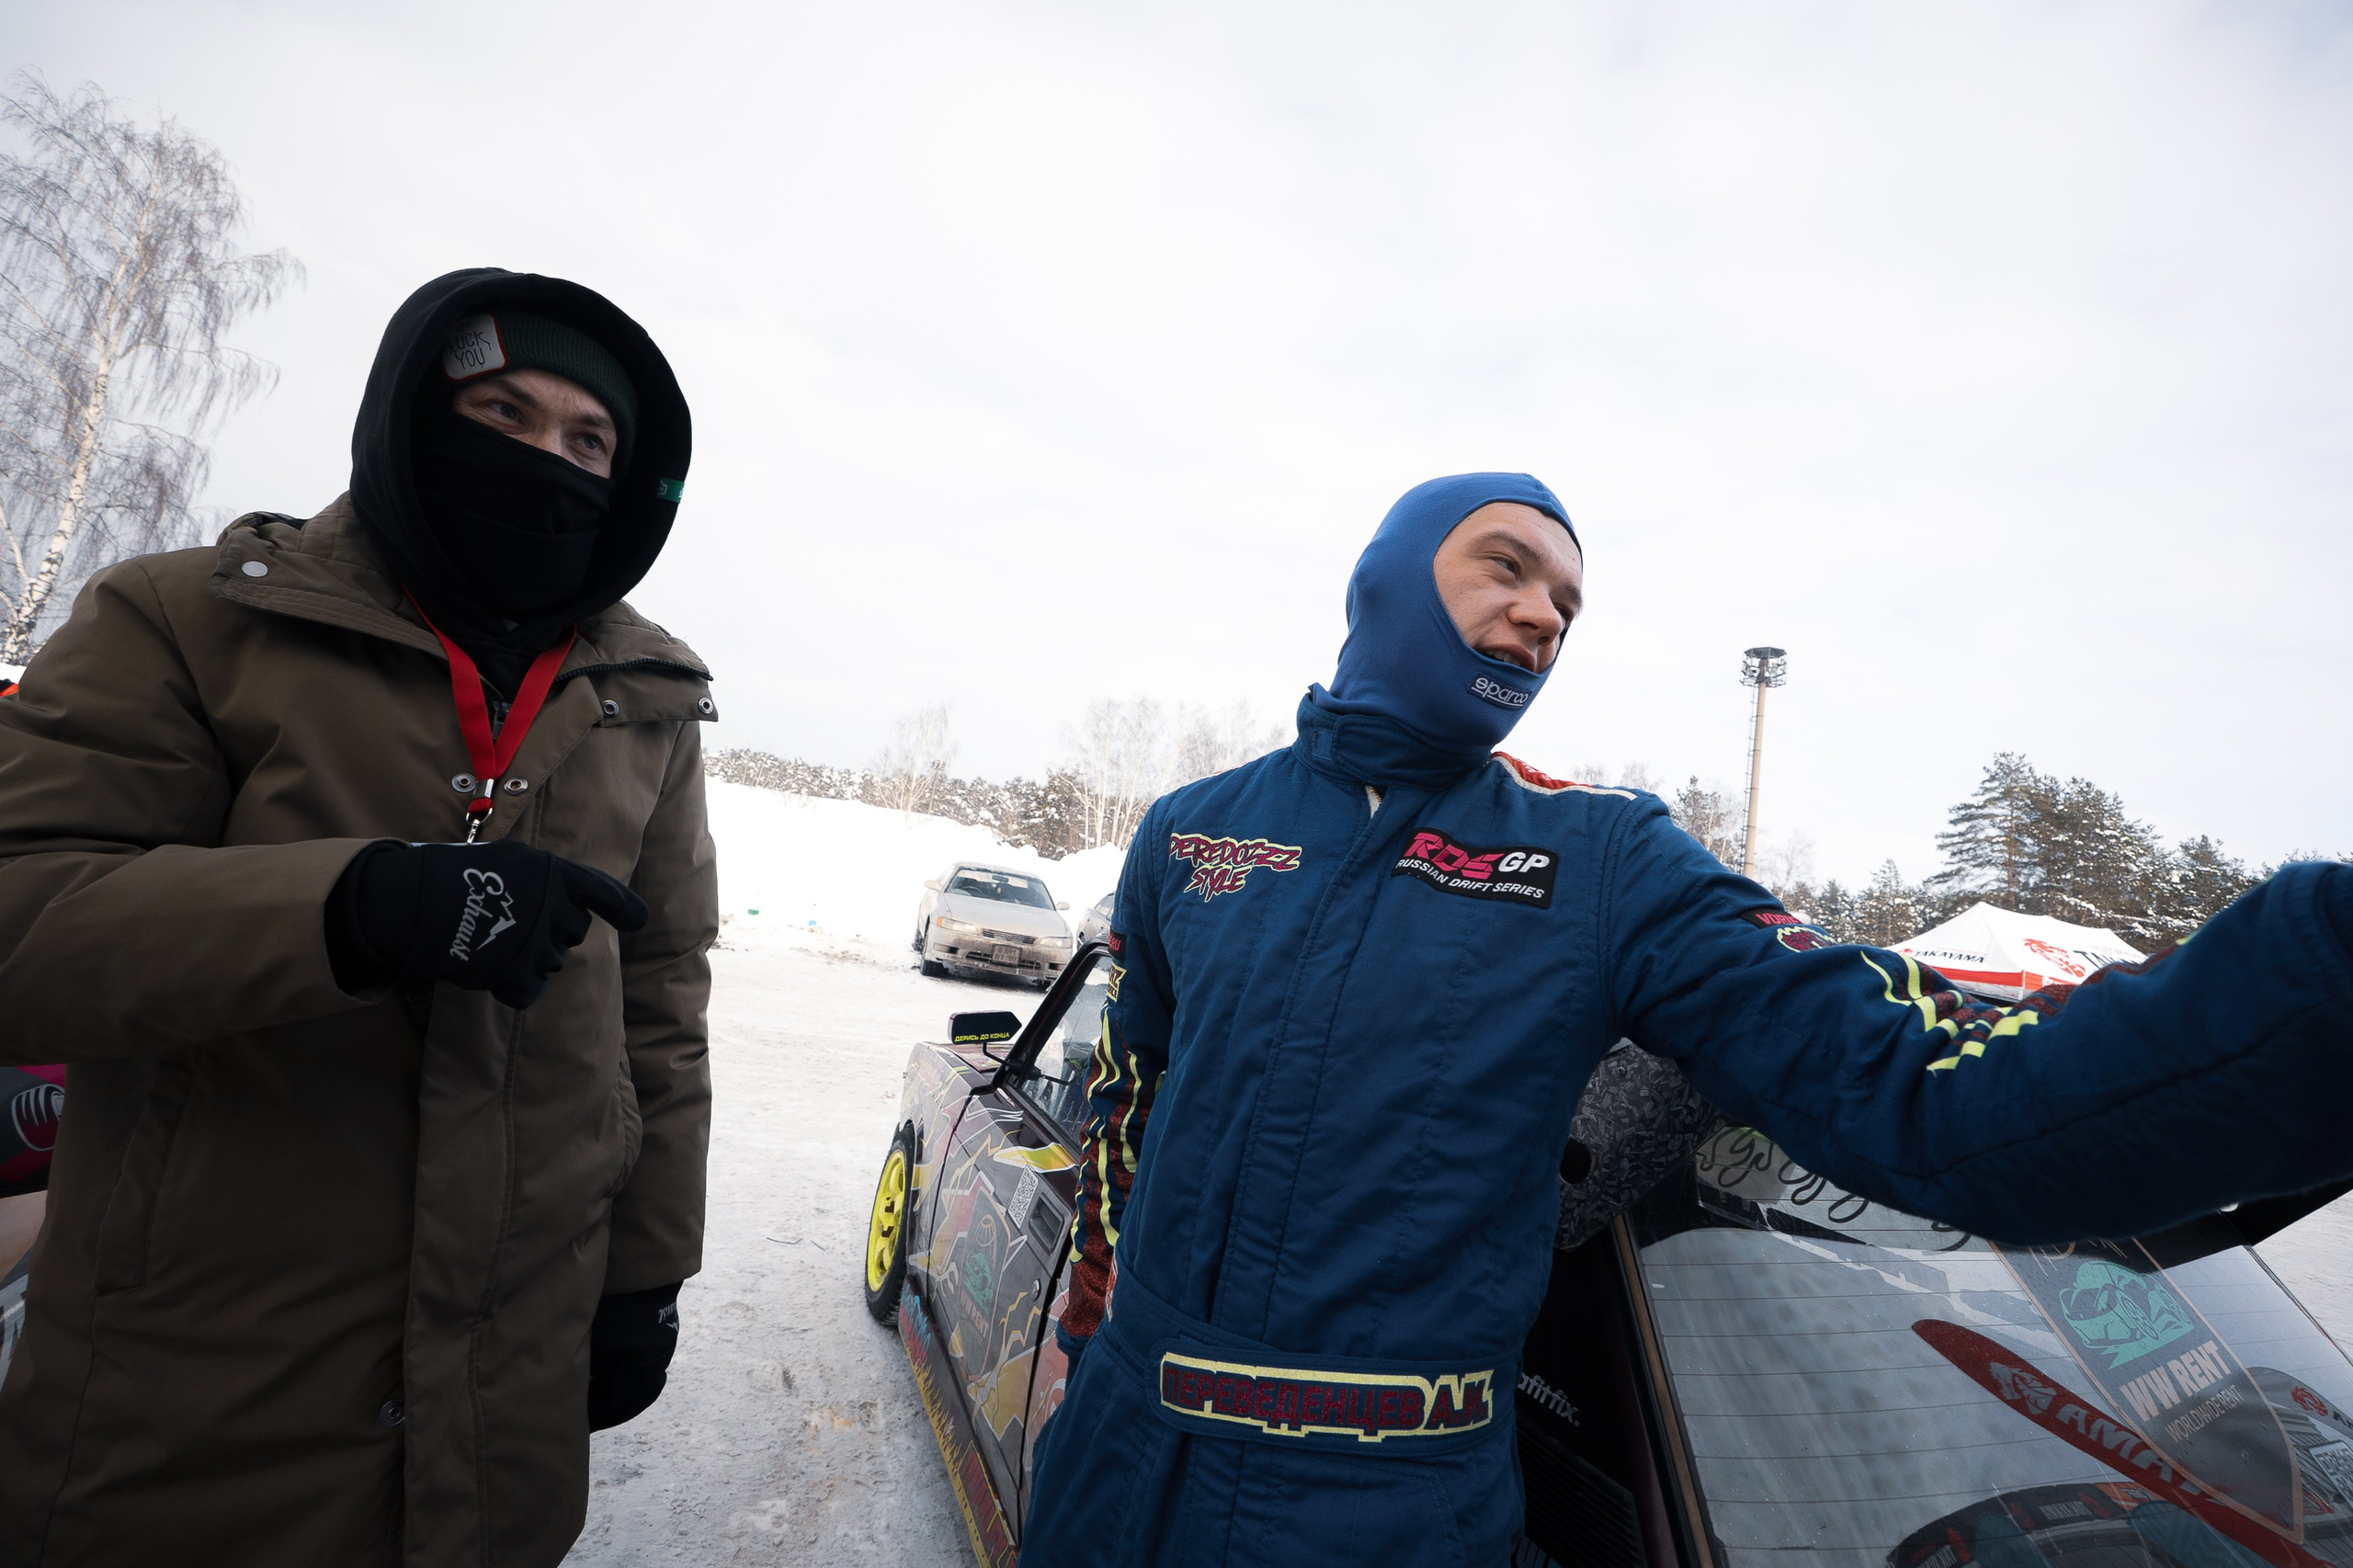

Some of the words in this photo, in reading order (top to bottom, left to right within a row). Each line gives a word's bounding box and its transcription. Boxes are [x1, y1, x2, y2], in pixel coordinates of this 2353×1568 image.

[455, 348, 485, 369] YOU
[1472, 677, 1529, 706] sparco
[1404, 833, 1505, 880] RDS
[1498, 851, 1550, 873] GP
[1184, 866, 1252, 903] STYLE
[1395, 858, 1449, 883] RUSSIAN
[1448, 878, 1494, 892] DRIFT
[1492, 882, 1545, 899] SERIES
[449, 869, 505, 961] Exhaust
[1915, 950, 1984, 963] TAKAYAMA
[955, 1034, 979, 1042] ДЕРИСЬ
[1164, 1366, 1425, 1437] ПЕРЕВЕДЕНЦЕВ
[2120, 1366, 2181, 1422] WW
[2167, 1340, 2231, 1397] RENT
[2165, 1396, 2224, 1443] WORLDWIDE
[2220, 1384, 2245, 1415] RENT
